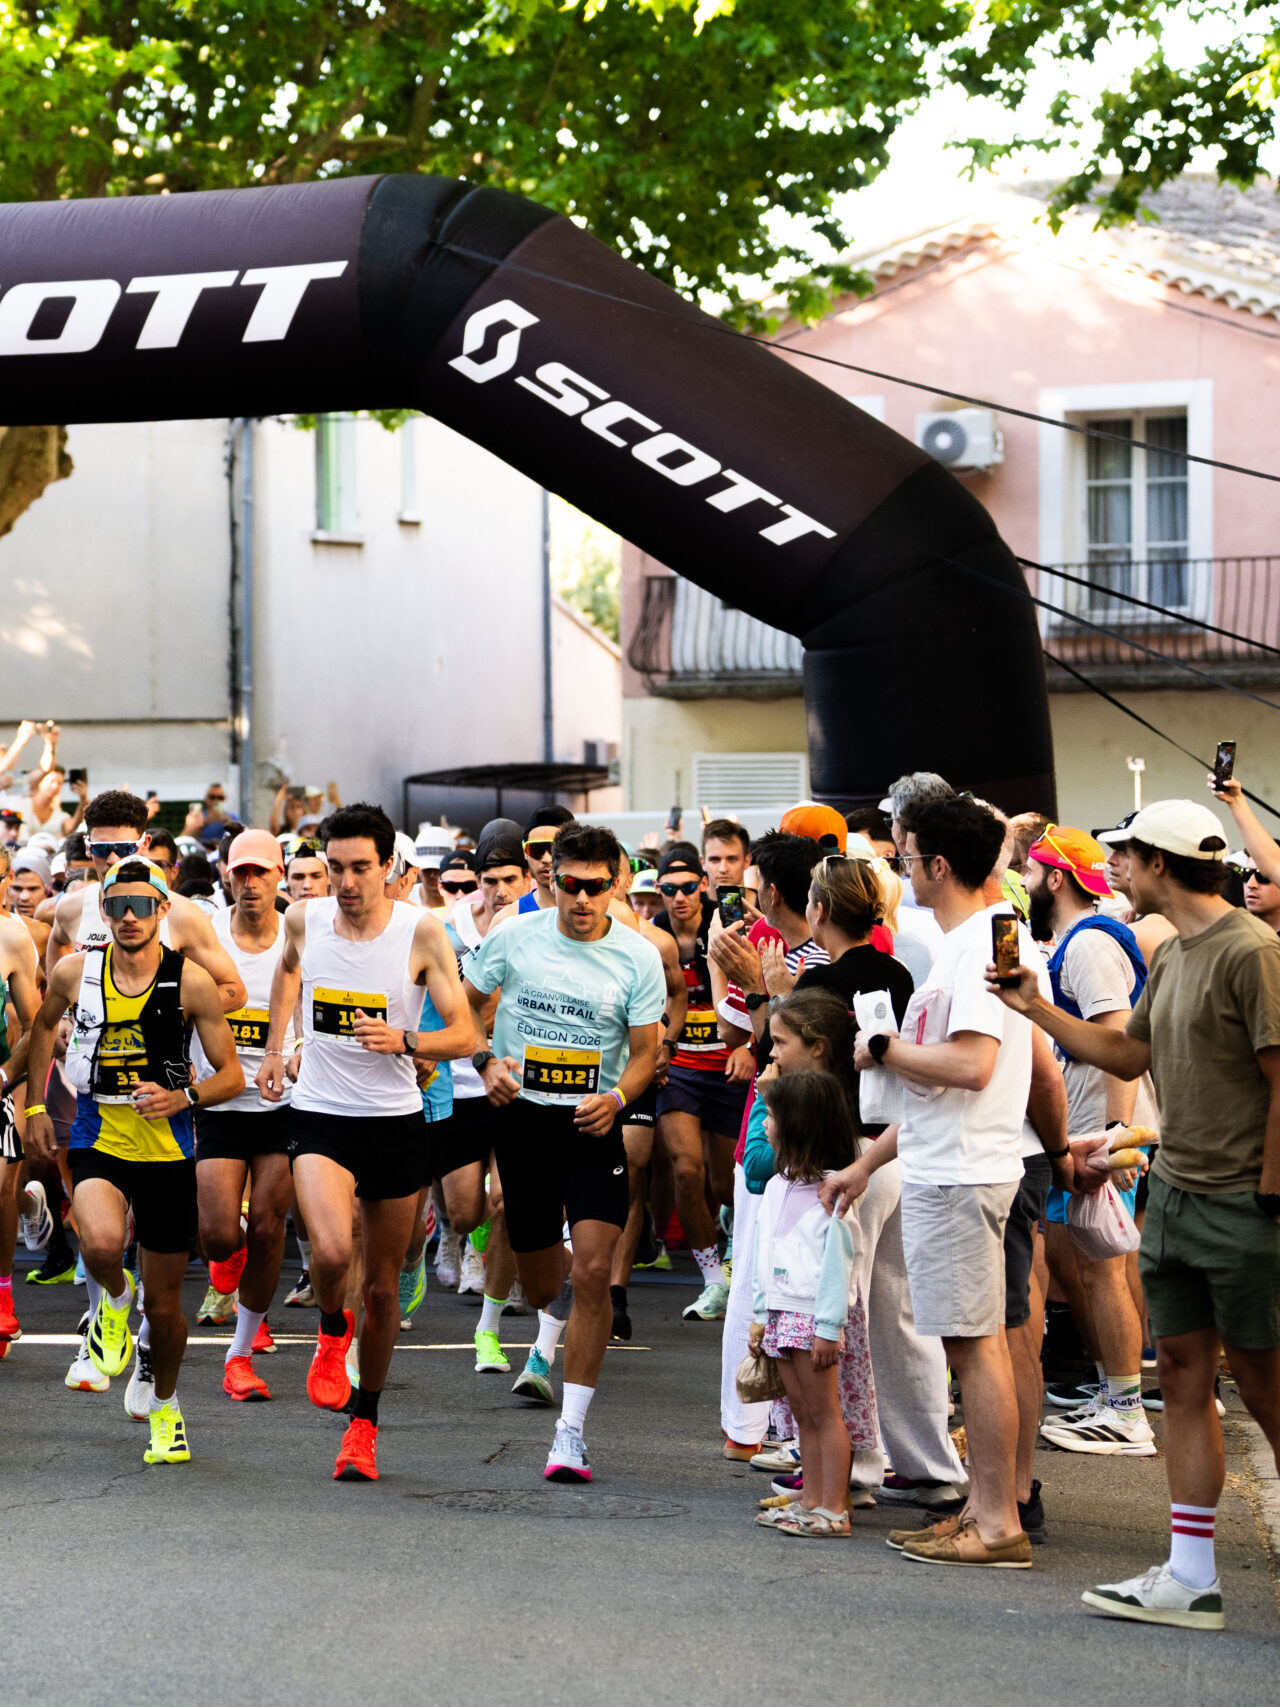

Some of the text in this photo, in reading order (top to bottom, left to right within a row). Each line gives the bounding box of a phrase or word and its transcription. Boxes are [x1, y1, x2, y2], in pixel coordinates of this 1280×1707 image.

[514, 361, 838, 547] SCOTT
[86, 933, 107, 942] JOLIE
[521, 986, 591, 1008] LA GRANVILLAISE
[517, 994, 595, 1020] URBAN TRAIL
[231, 1024, 261, 1040] 181
[517, 1020, 601, 1046] ÉDITION 2026
[685, 1026, 711, 1038] 147
[116, 1071, 140, 1086] 33
[539, 1067, 587, 1085] 1912
